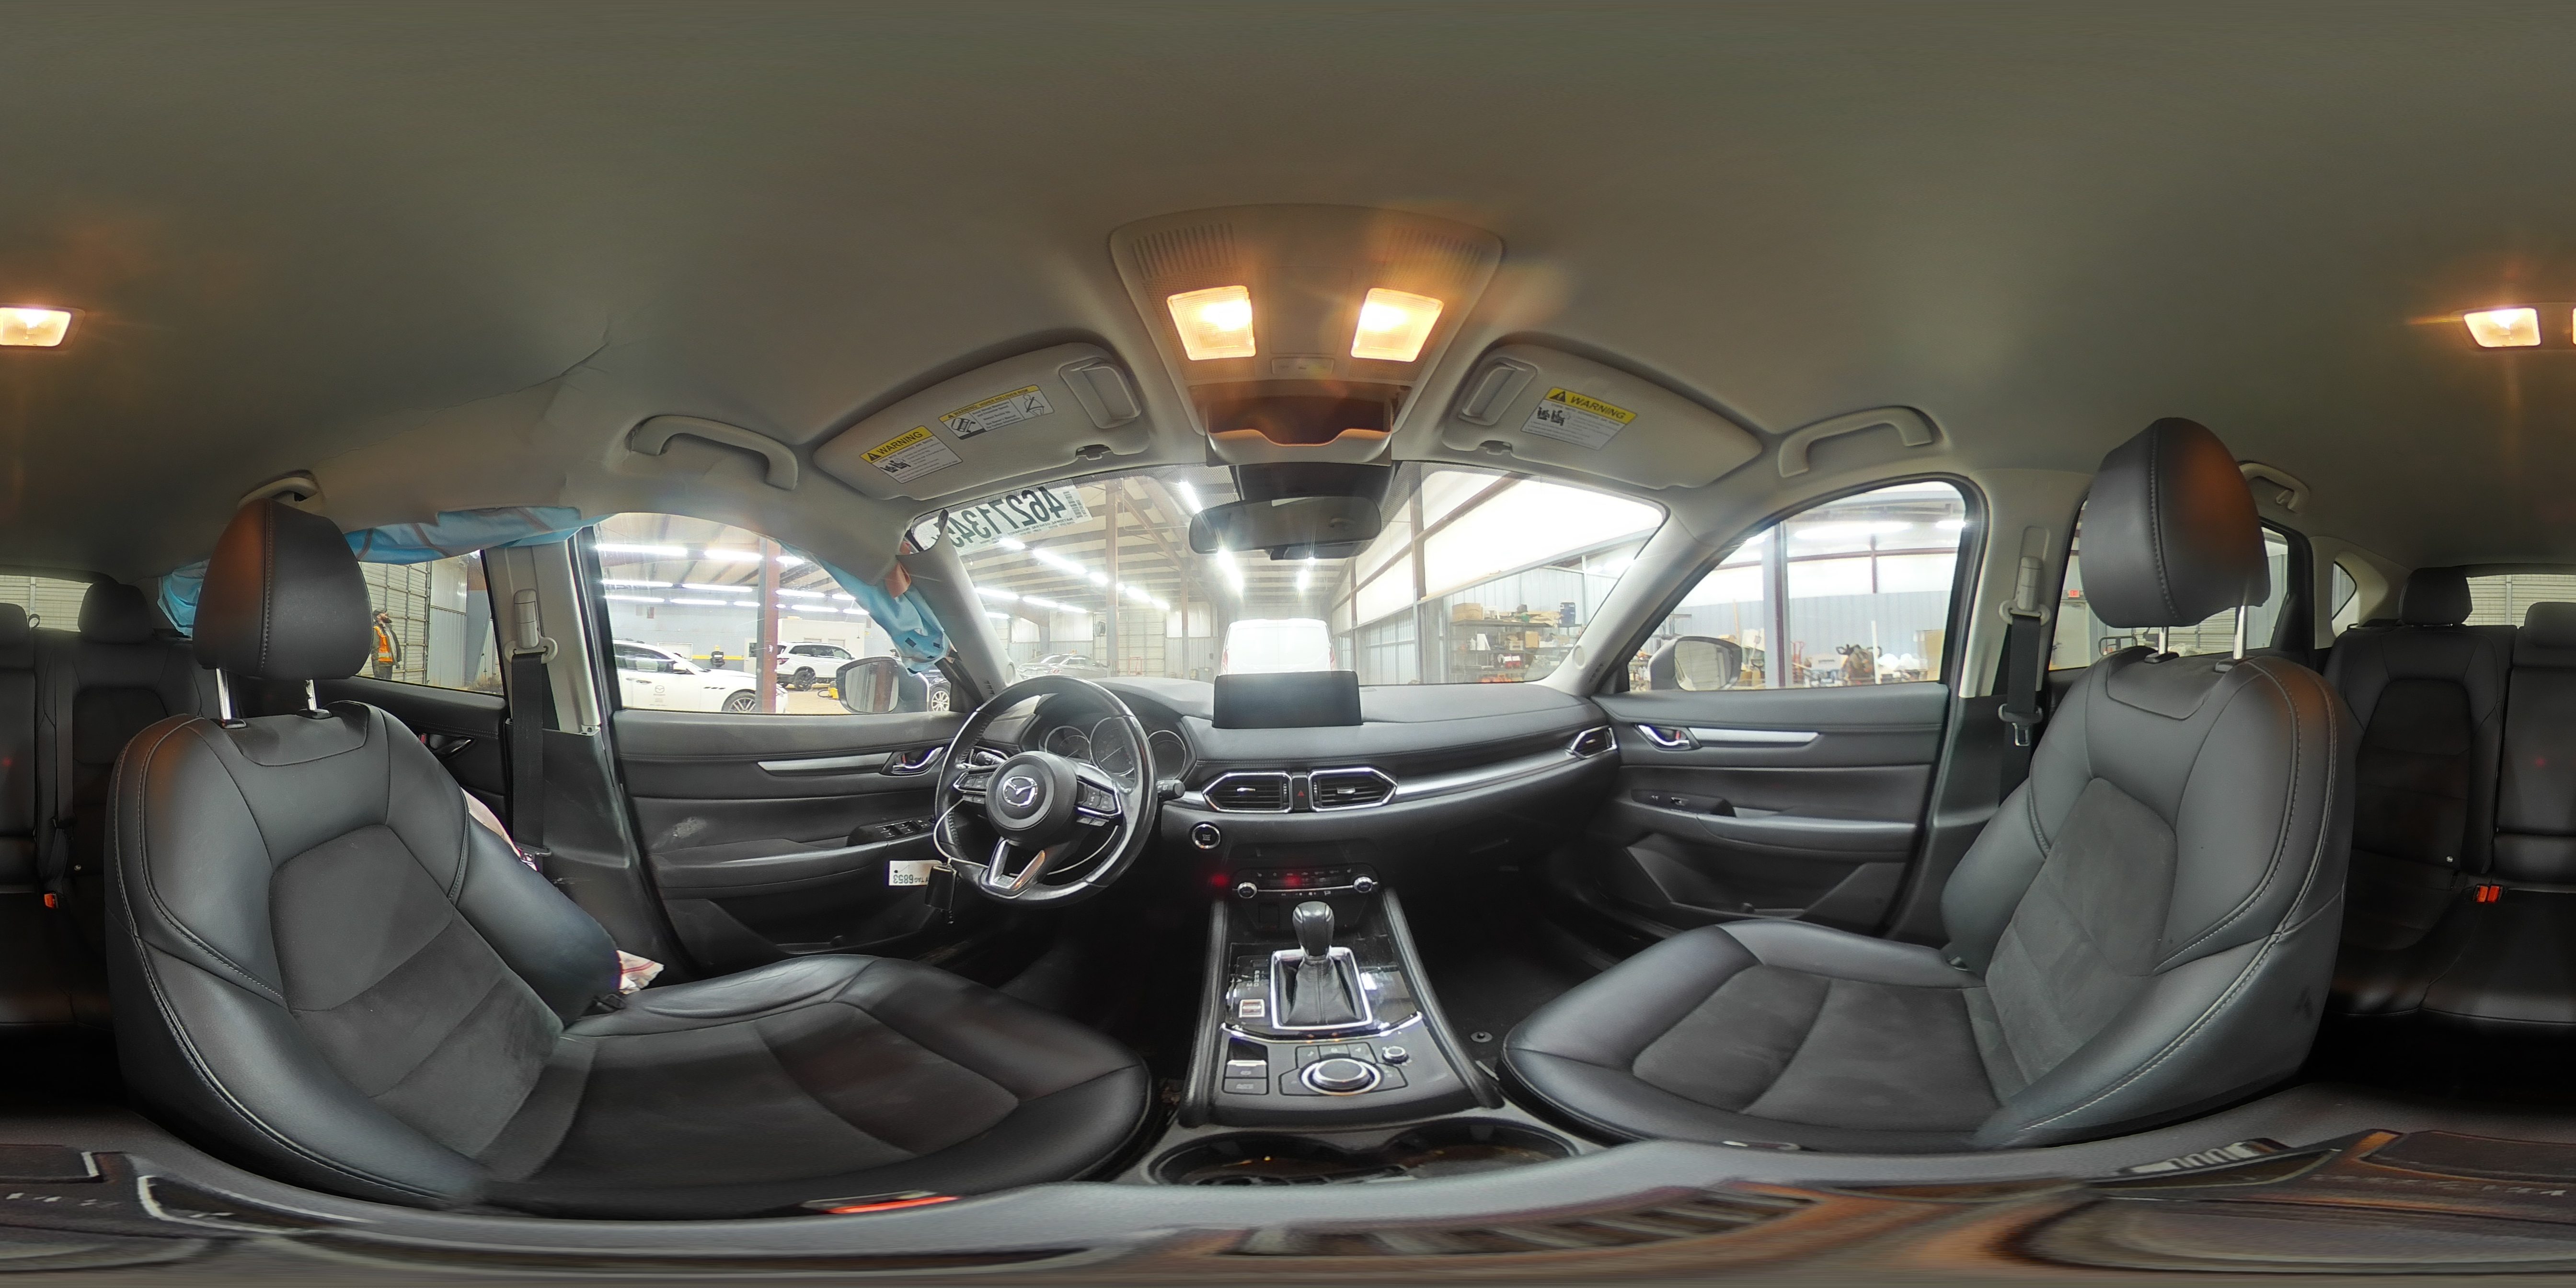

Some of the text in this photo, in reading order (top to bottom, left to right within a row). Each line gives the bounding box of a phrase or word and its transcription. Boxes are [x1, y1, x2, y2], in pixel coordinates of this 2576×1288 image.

[1570, 396, 1626, 419] WARNING
[876, 432, 923, 454] WARNING
[893, 874, 913, 884] 6853
